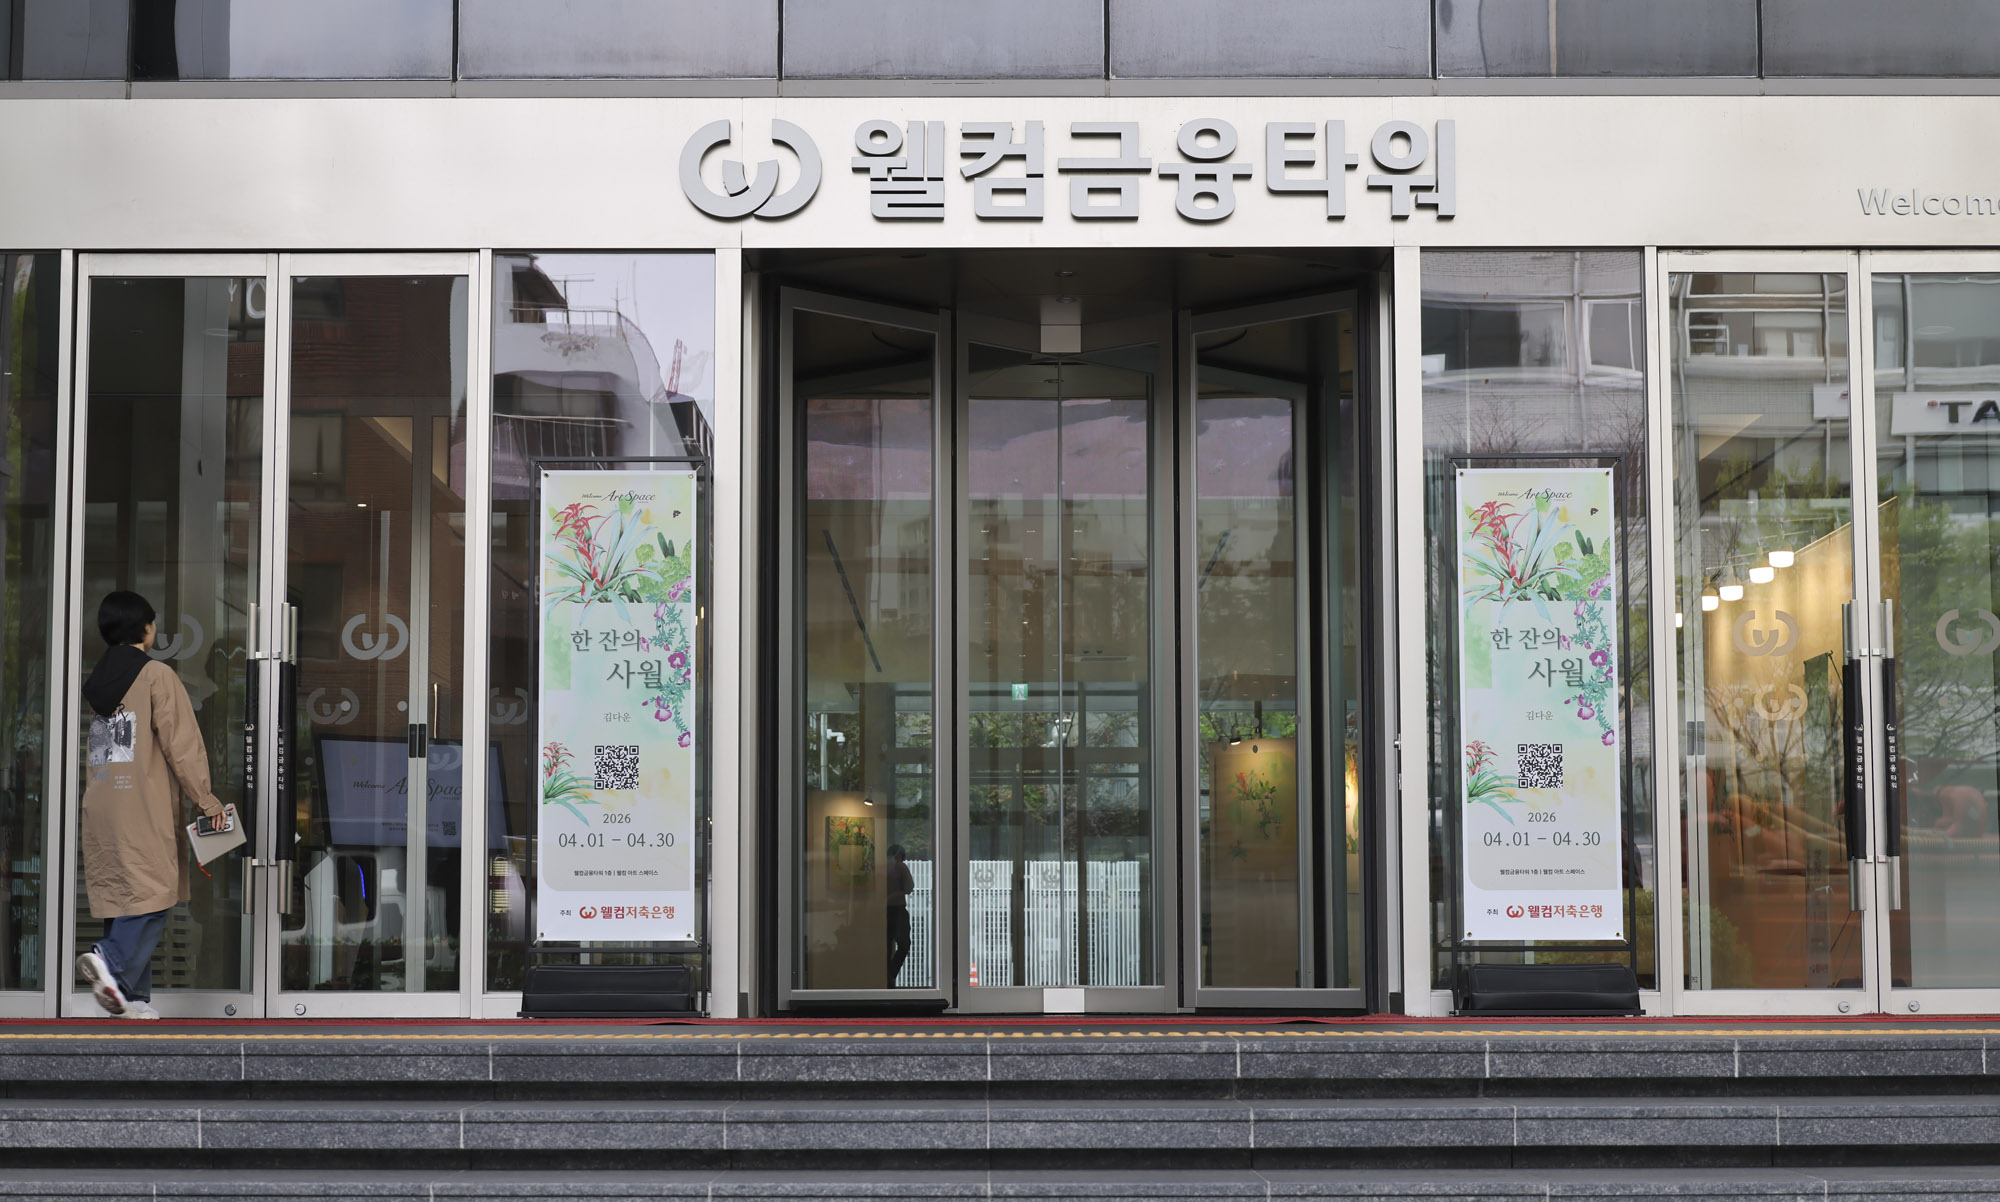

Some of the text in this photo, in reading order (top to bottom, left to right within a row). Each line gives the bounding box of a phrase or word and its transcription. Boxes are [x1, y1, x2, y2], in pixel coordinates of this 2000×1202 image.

[851, 117, 1457, 223] 웰컴금융타워
[1857, 187, 2000, 216] Welcom
[601, 489, 624, 502] Art
[624, 489, 656, 505] Space
[1517, 487, 1541, 500] Art
[1541, 487, 1573, 503] Space
[570, 628, 641, 652] 한 잔의
[1489, 627, 1561, 650] 한 잔의
[606, 659, 662, 689] 사월
[1527, 657, 1584, 687] 사월
[603, 712, 631, 723] 김다운
[1526, 710, 1554, 721] 김다운
[353, 780, 386, 789] Welcome
[602, 813, 631, 824] 2026
[1527, 812, 1557, 823] 2026
[558, 832, 604, 848] 04.01
[627, 832, 674, 848] 04.30
[1483, 831, 1530, 847] 04.01
[1553, 831, 1600, 847] 04.30
[600, 905, 675, 920] 웰컴저축은행
[1527, 904, 1603, 919] 웰컴저축은행
